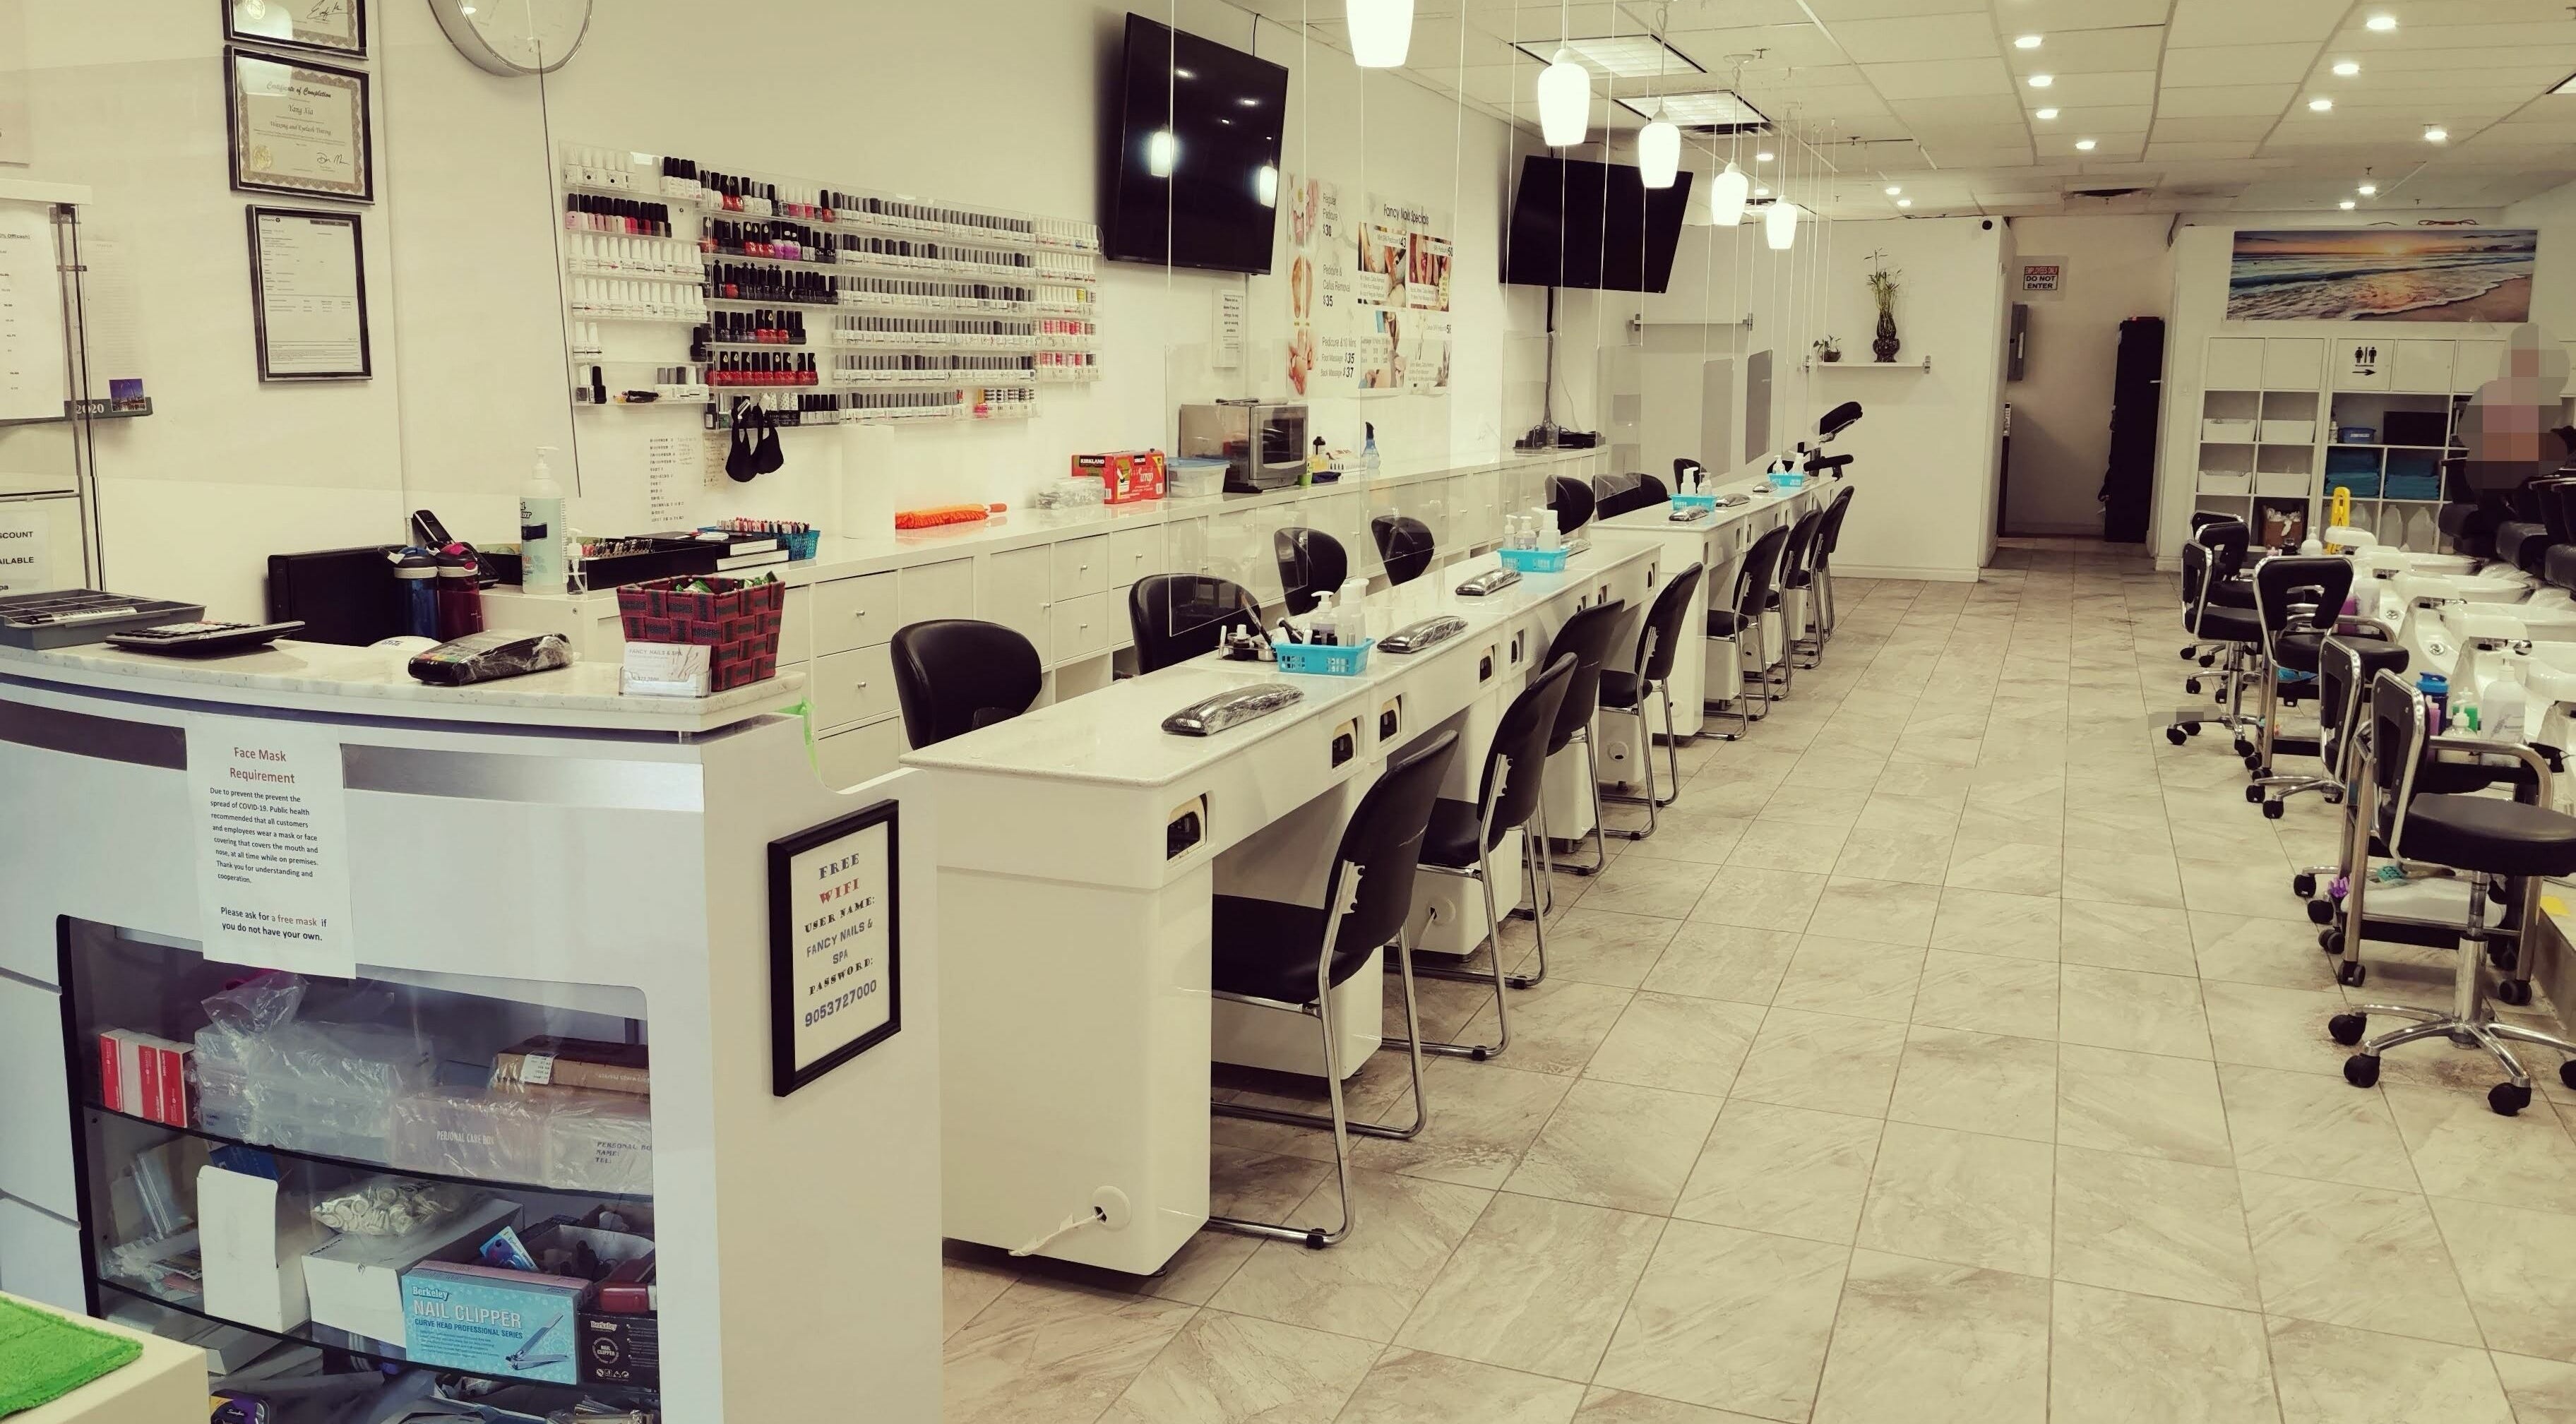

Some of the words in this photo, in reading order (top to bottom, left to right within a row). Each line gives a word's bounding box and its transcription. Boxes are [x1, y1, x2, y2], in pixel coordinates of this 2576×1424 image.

[297, 87, 302, 95] of
[304, 86, 331, 98] Completion
[1384, 203, 1399, 221] Fancy
[1400, 207, 1410, 221] Nails
[1411, 210, 1429, 225] Specials
[1323, 294, 1333, 307] $35
[1344, 352, 1355, 364] $35
[1342, 366, 1354, 378] $37
[234, 747, 256, 760] Face
[258, 748, 287, 762] Mask
[229, 767, 295, 784] Requirement
[231, 789, 254, 798] prevent
[265, 792, 289, 802] prevent
[210, 800, 230, 809] spread
[239, 802, 269, 813] COVID-19.
[270, 806, 289, 814] Public
[290, 806, 310, 816] health
[211, 813, 253, 822] recommended
[276, 819, 309, 828] customers
[224, 827, 256, 836] employees
[278, 830, 295, 839] mask
[304, 833, 318, 842] face
[214, 837, 237, 846] covering
[251, 841, 271, 849] covers
[273, 842, 283, 851] the
[284, 844, 305, 853] mouth
[306, 845, 318, 854] and
[261, 854, 278, 863] while
[289, 856, 318, 866] premises.
[818, 852, 860, 880] FREE
[216, 860, 233, 869] Thank
[255, 866, 300, 878] understanding
[301, 869, 313, 878] and
[217, 873, 252, 883] cooperation.
[819, 877, 860, 905] WIFI
[220, 907, 244, 918] Please
[245, 911, 256, 920] ask
[258, 912, 270, 921] for
[278, 914, 294, 924] free
[296, 917, 317, 926] mask
[321, 919, 327, 927] if
[804, 912, 835, 934] USER
[840, 896, 876, 920] NAME:
[222, 922, 235, 931] you
[237, 923, 246, 932] do
[249, 926, 261, 934] not
[262, 927, 281, 936] have
[806, 934, 837, 957] FANCY
[840, 921, 866, 943] NAILS
[866, 918, 873, 928] &
[833, 947, 849, 964] SPA
[808, 957, 874, 996] PASSWORD:
[804, 979, 878, 1028] 9053727000
[597, 1142, 637, 1150] PERSONAL
[412, 1286, 449, 1301] Berkeley
[413, 1300, 450, 1320] NAIL
[455, 1305, 522, 1329] CLIPPER
[415, 1318, 435, 1327] CURVE
[454, 1324, 500, 1336] PROFESSIONAL
[501, 1330, 523, 1339] SERIES
[590, 1321, 617, 1332] Berkeley
